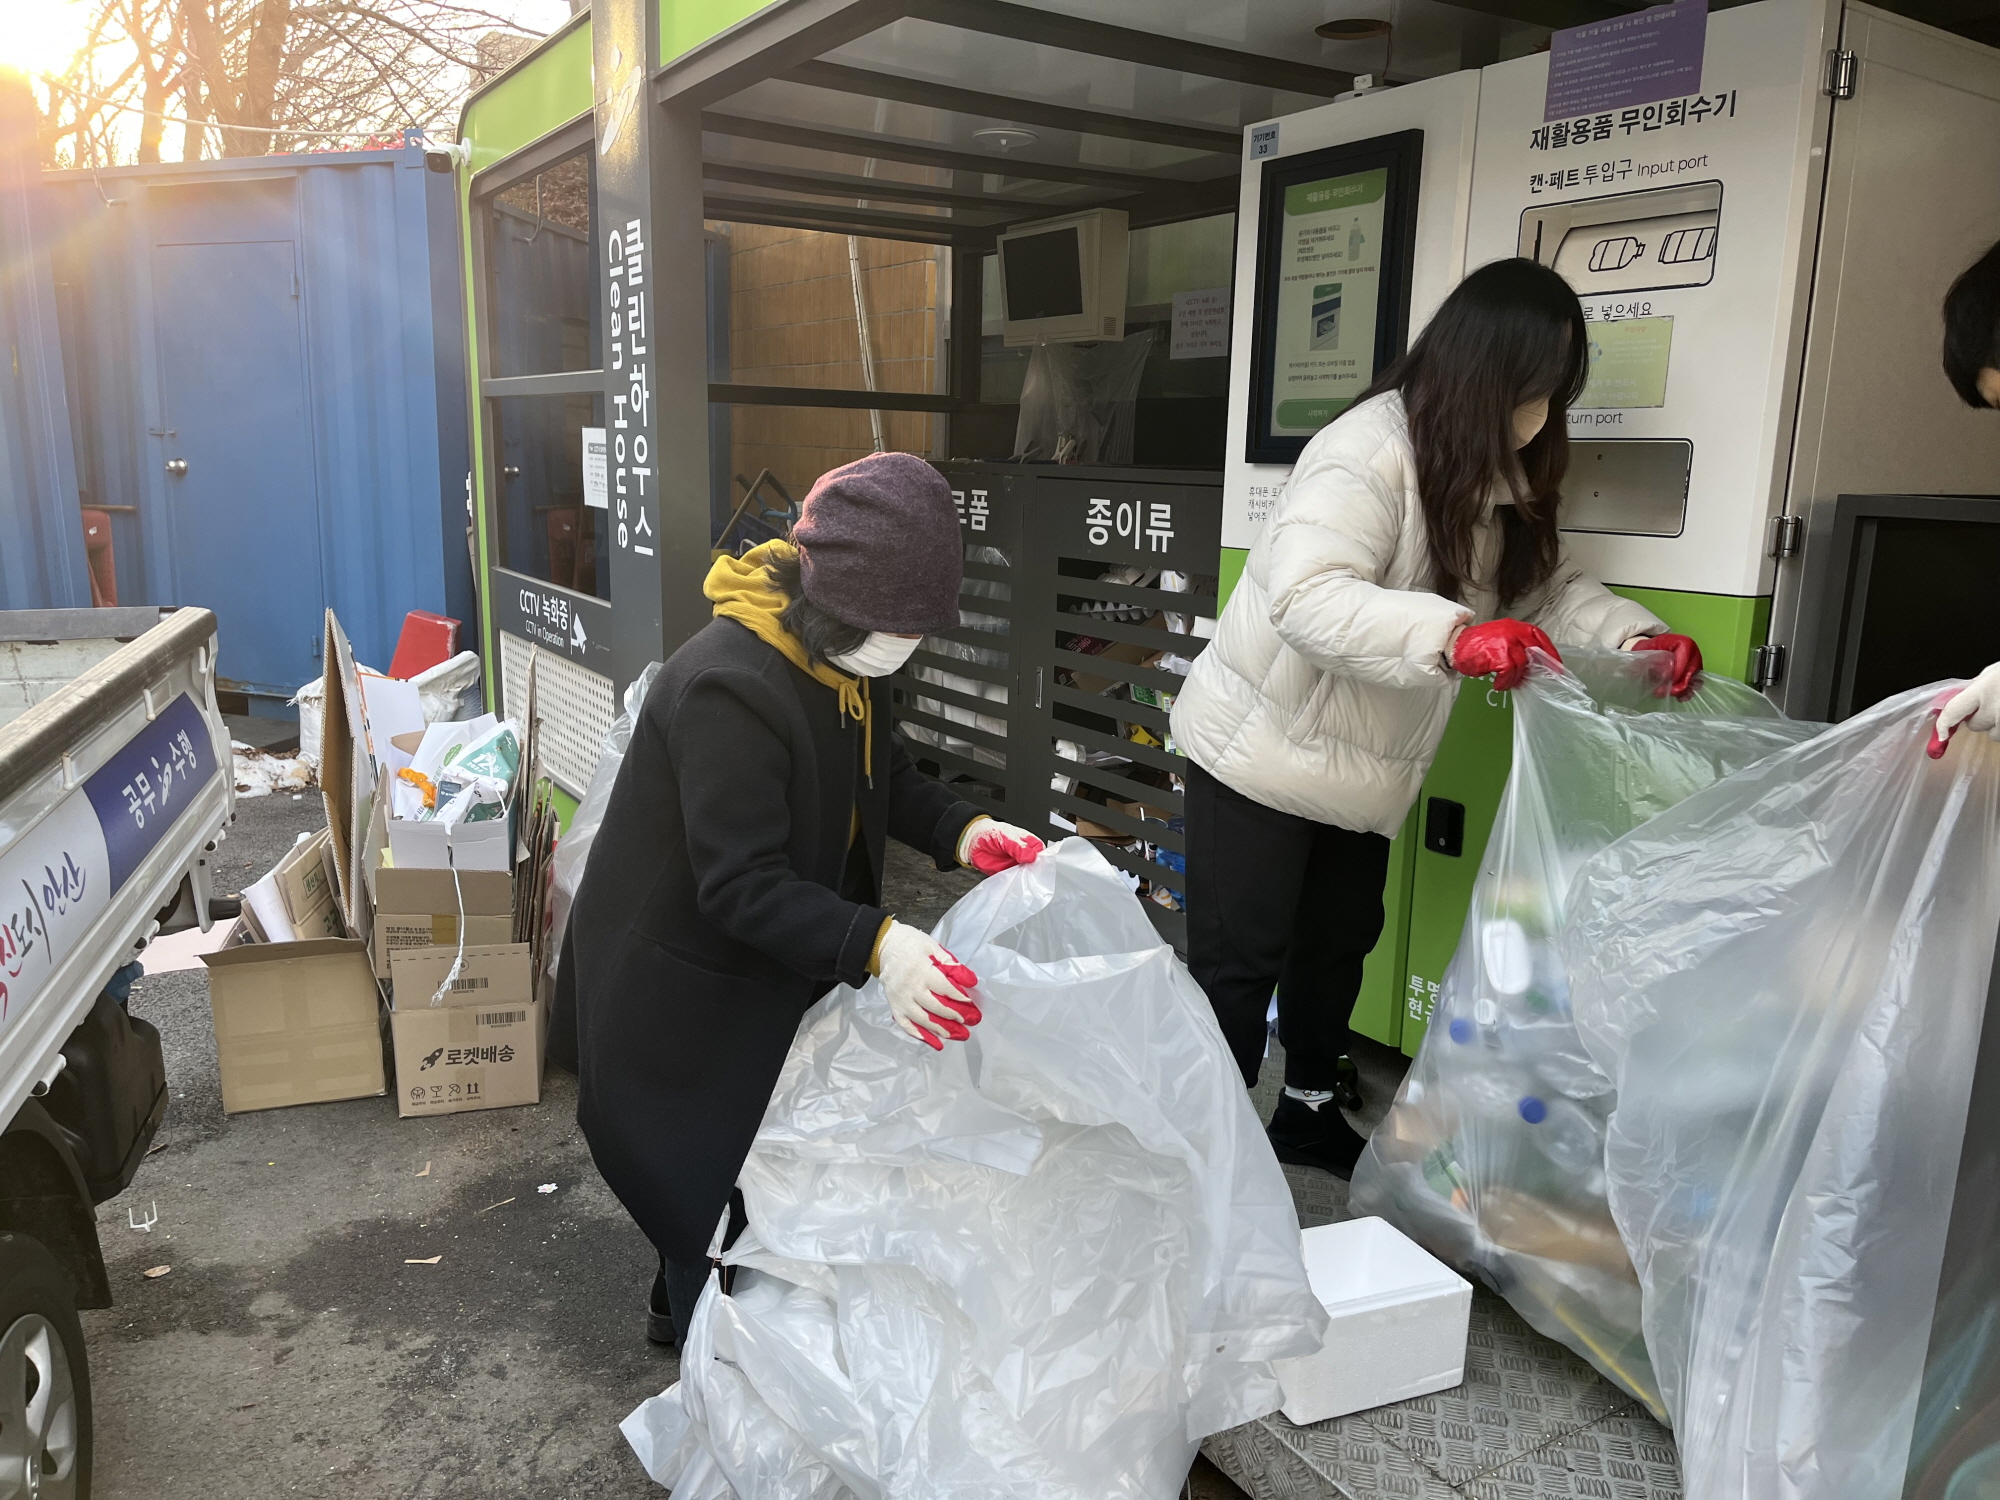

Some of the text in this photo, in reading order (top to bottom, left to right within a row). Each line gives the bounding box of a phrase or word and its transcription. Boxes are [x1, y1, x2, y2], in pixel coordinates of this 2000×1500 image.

[1600, 25, 1611, 33] 사용
[1633, 17, 1645, 26] 확인
[1529, 113, 1614, 150] 재활용품
[1618, 90, 1736, 135] 무인회수기
[1253, 130, 1276, 143] 기기번호
[1258, 144, 1268, 155] 33
[1637, 159, 1675, 178] Input
[1677, 154, 1708, 174] port
[1601, 301, 1652, 322] 넣으세요
[608, 229, 629, 549] Clean House
[625, 218, 655, 557] 클린하우스
[1596, 412, 1623, 426] port
[1249, 486, 1269, 497] 휴대폰
[1086, 498, 1174, 553] 종이류
[520, 589, 569, 631] CCTV 녹화중
[525, 619, 565, 648] CCTV in Operation
[121, 728, 197, 829] 공무 수행
[42, 851, 86, 917] 안산
[445, 1044, 515, 1066] 로켓배송
